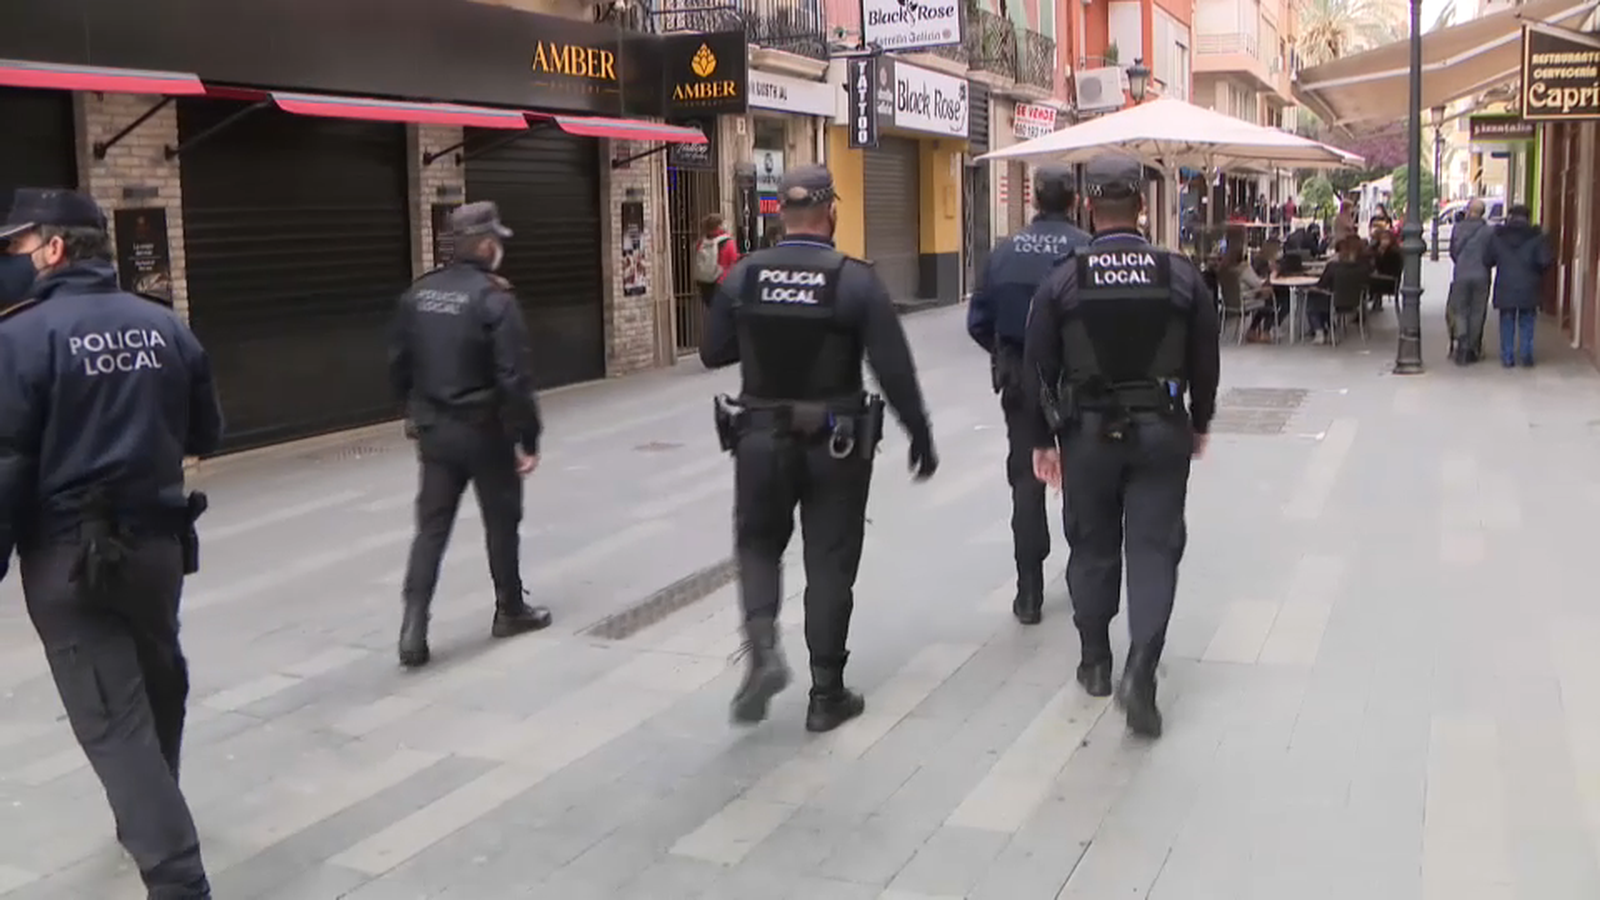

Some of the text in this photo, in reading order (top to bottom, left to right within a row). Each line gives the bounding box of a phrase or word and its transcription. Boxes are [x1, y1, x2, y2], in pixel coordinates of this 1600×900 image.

[868, 5, 954, 26] Black Rose
[532, 39, 616, 81] AMBER
[673, 80, 736, 100] AMBER
[1529, 82, 1600, 113] Capri
[857, 61, 868, 144] TATTOO
[898, 79, 930, 119] Black
[934, 88, 961, 122] Rose
[1013, 233, 1067, 245] POLICIA
[1015, 243, 1059, 254] LOCAL
[1088, 252, 1155, 268] POLICIA
[758, 269, 826, 286] POLICIA
[1094, 270, 1150, 285] LOCAL
[761, 287, 818, 304] LOCAL
[69, 329, 166, 356] POLICIA
[84, 350, 162, 376] LOCAL
